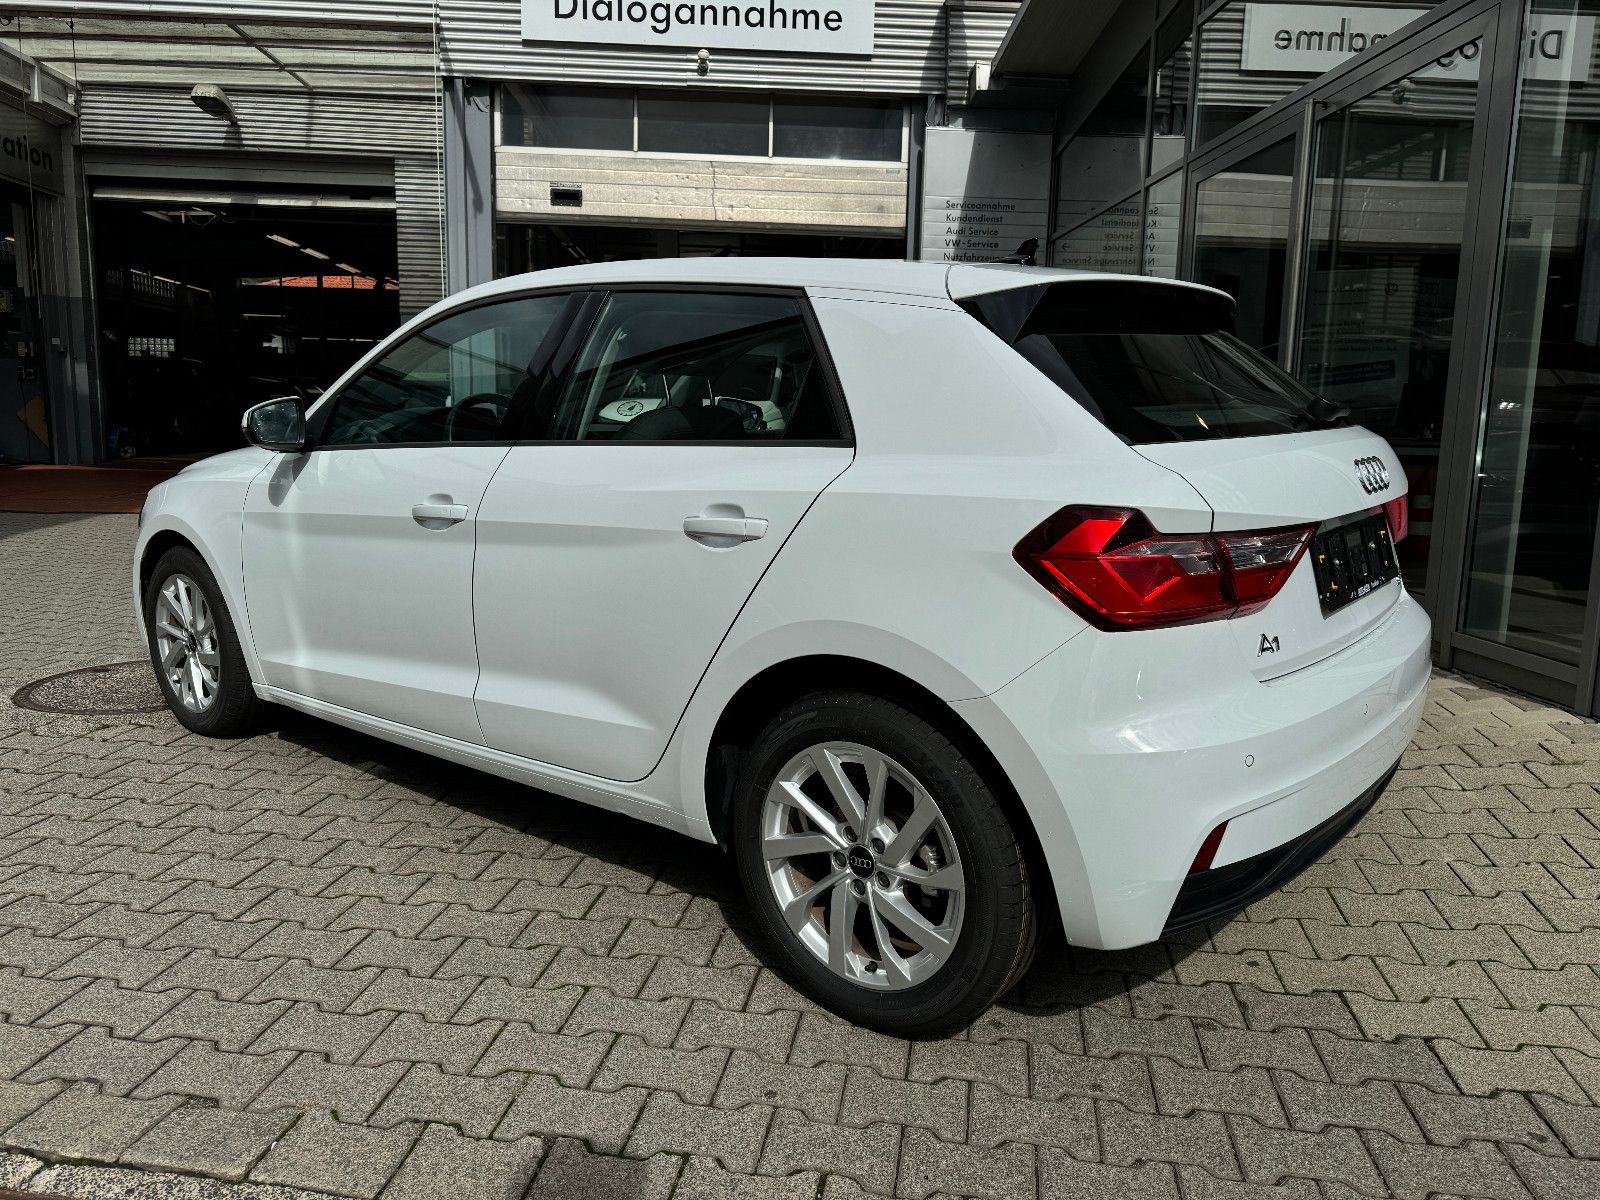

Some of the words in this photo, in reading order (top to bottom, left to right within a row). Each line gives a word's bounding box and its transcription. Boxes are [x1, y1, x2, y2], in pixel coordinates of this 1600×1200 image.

[554, 0, 844, 35] Dialogannahme
[0, 134, 53, 172] ation
[945, 200, 1016, 211] Serviceannahme
[945, 213, 1003, 224] Kundendienst
[945, 226, 966, 237] Audi
[968, 227, 999, 237] Service
[944, 239, 999, 249] VW-Service
[1256, 633, 1281, 658] A1
